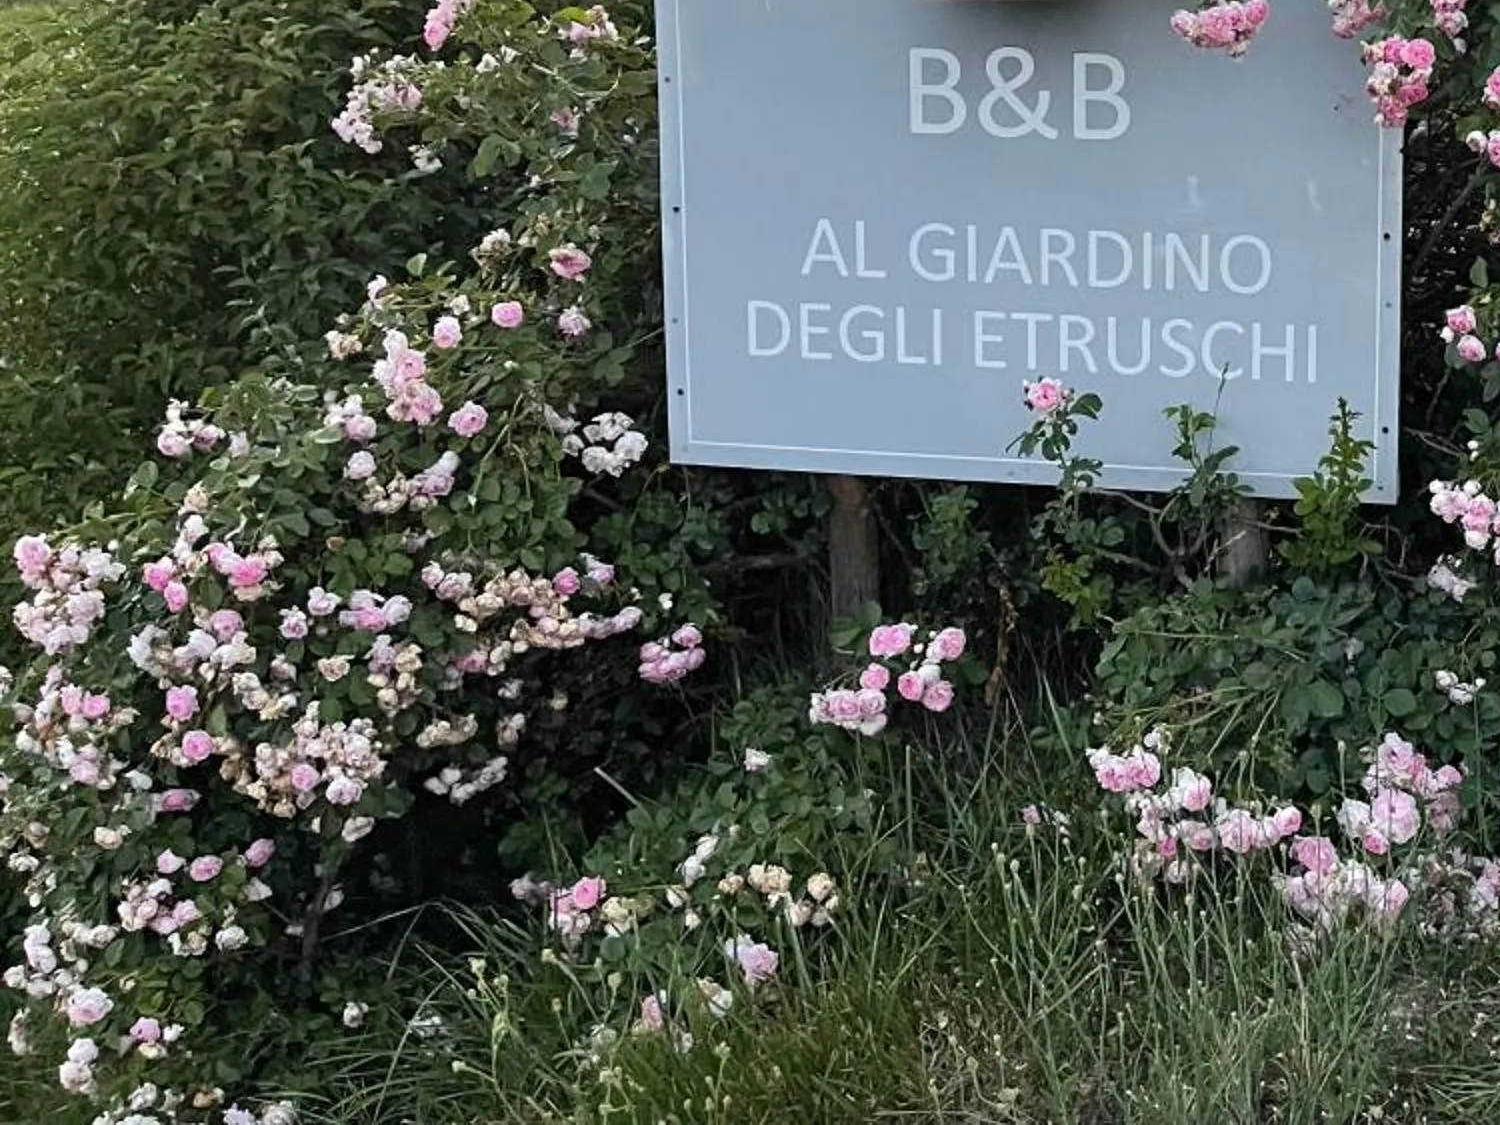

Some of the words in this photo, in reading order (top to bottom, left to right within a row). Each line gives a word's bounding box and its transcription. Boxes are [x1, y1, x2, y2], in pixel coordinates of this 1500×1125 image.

[908, 46, 1132, 141] B&B
[800, 218, 887, 279] AL
[908, 223, 1272, 295] GIARDINO
[746, 299, 943, 367] DEGLI
[974, 311, 1319, 383] ETRUSCHI
